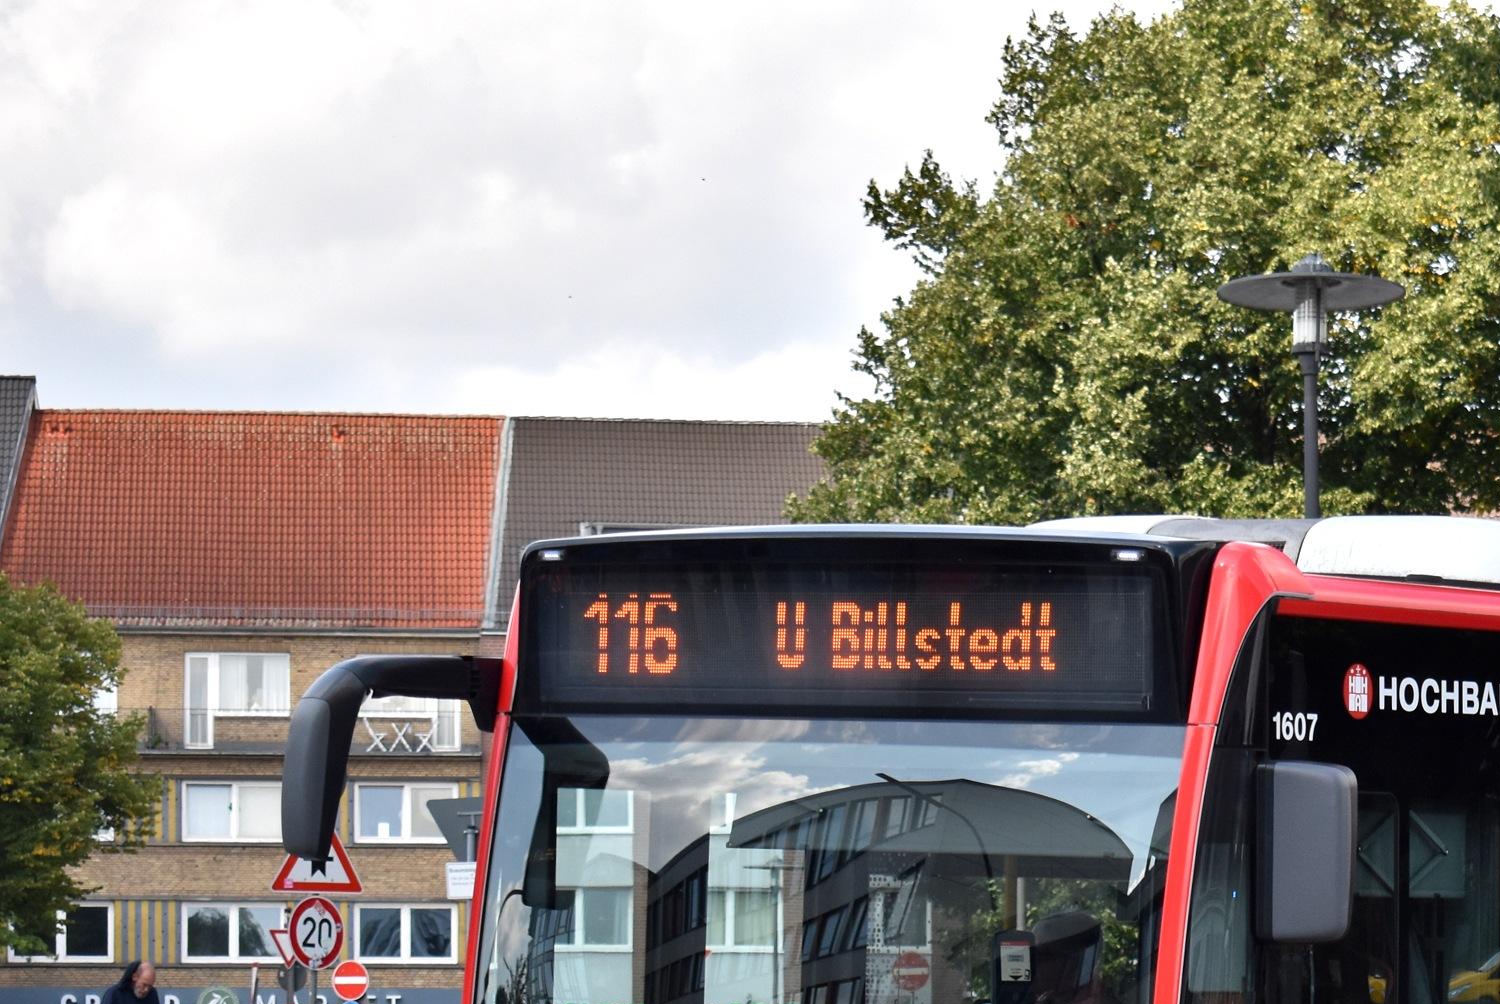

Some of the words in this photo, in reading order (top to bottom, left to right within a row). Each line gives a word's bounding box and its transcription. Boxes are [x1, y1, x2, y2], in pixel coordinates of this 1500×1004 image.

[584, 592, 678, 674] 116
[776, 601, 806, 669] U
[832, 601, 1057, 671] Billstedt
[1272, 711, 1319, 742] 1607
[302, 916, 332, 948] 20
